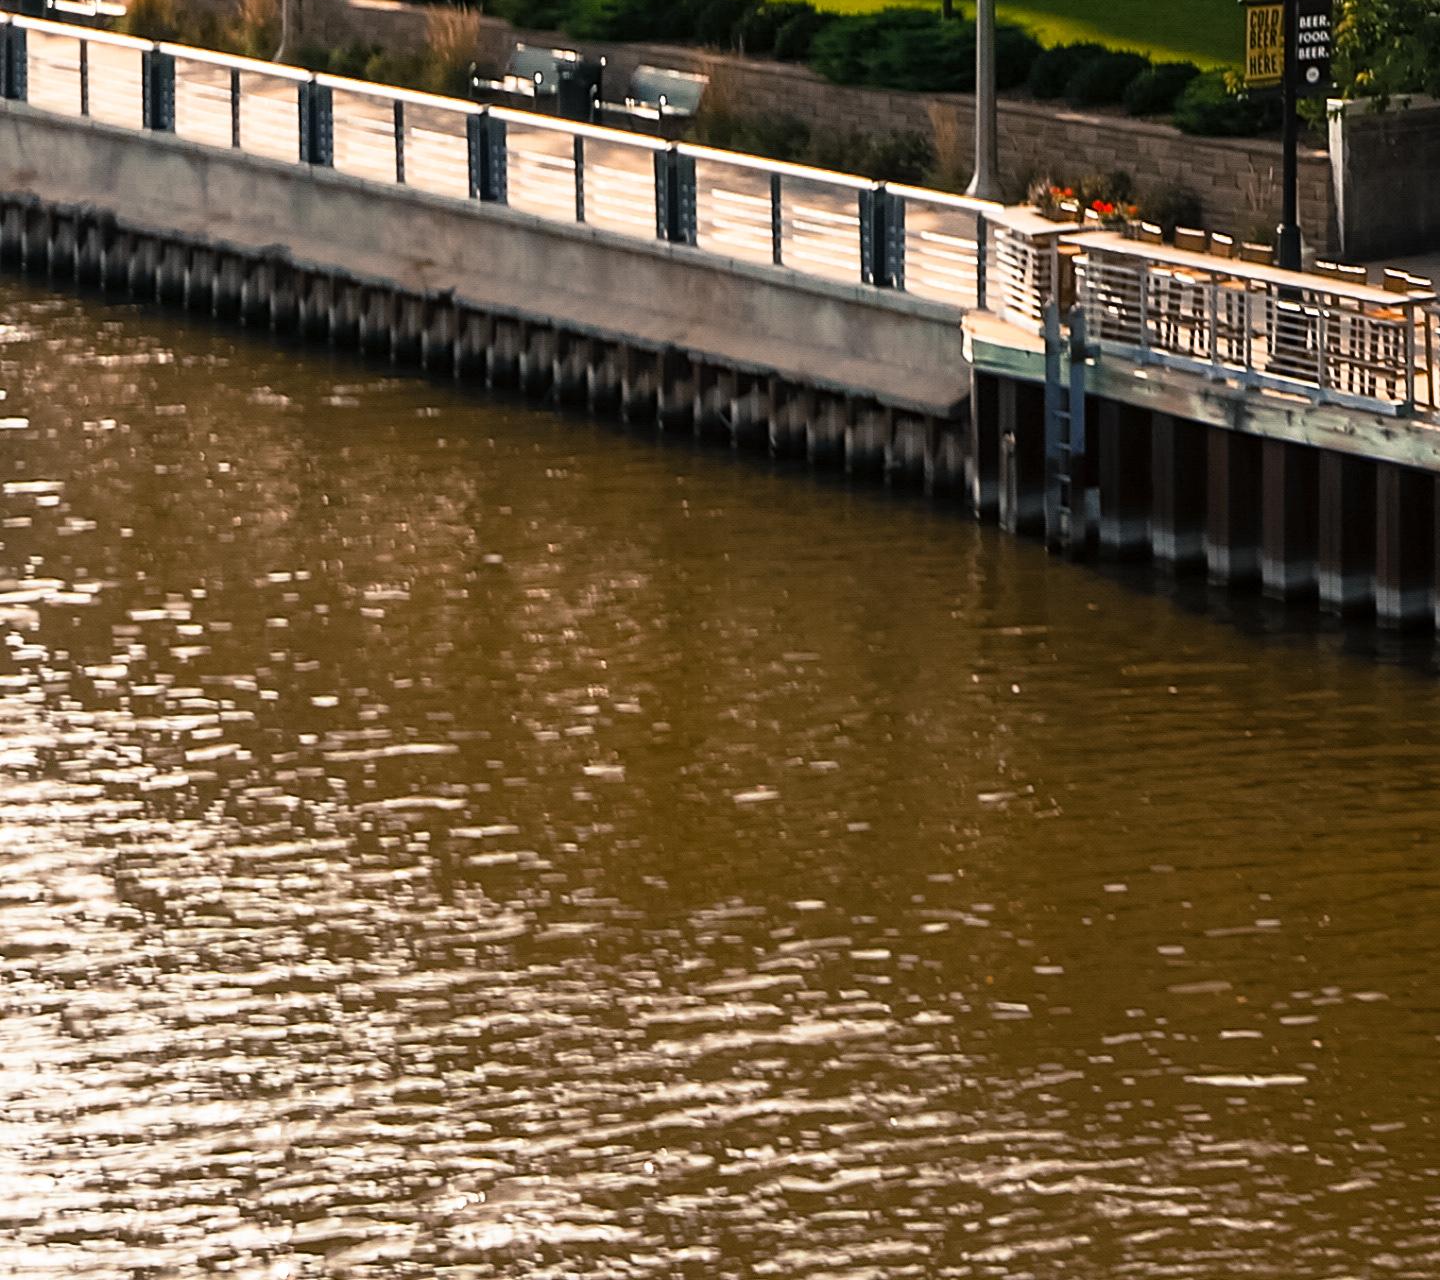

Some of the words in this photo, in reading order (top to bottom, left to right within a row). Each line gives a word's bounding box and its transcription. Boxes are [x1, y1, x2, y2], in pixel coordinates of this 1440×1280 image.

[1250, 8, 1279, 27] COLD
[1299, 15, 1330, 29] BEER.
[1250, 29, 1278, 48] BEER
[1298, 46, 1329, 60] BEER.
[1250, 54, 1277, 76] HERE
